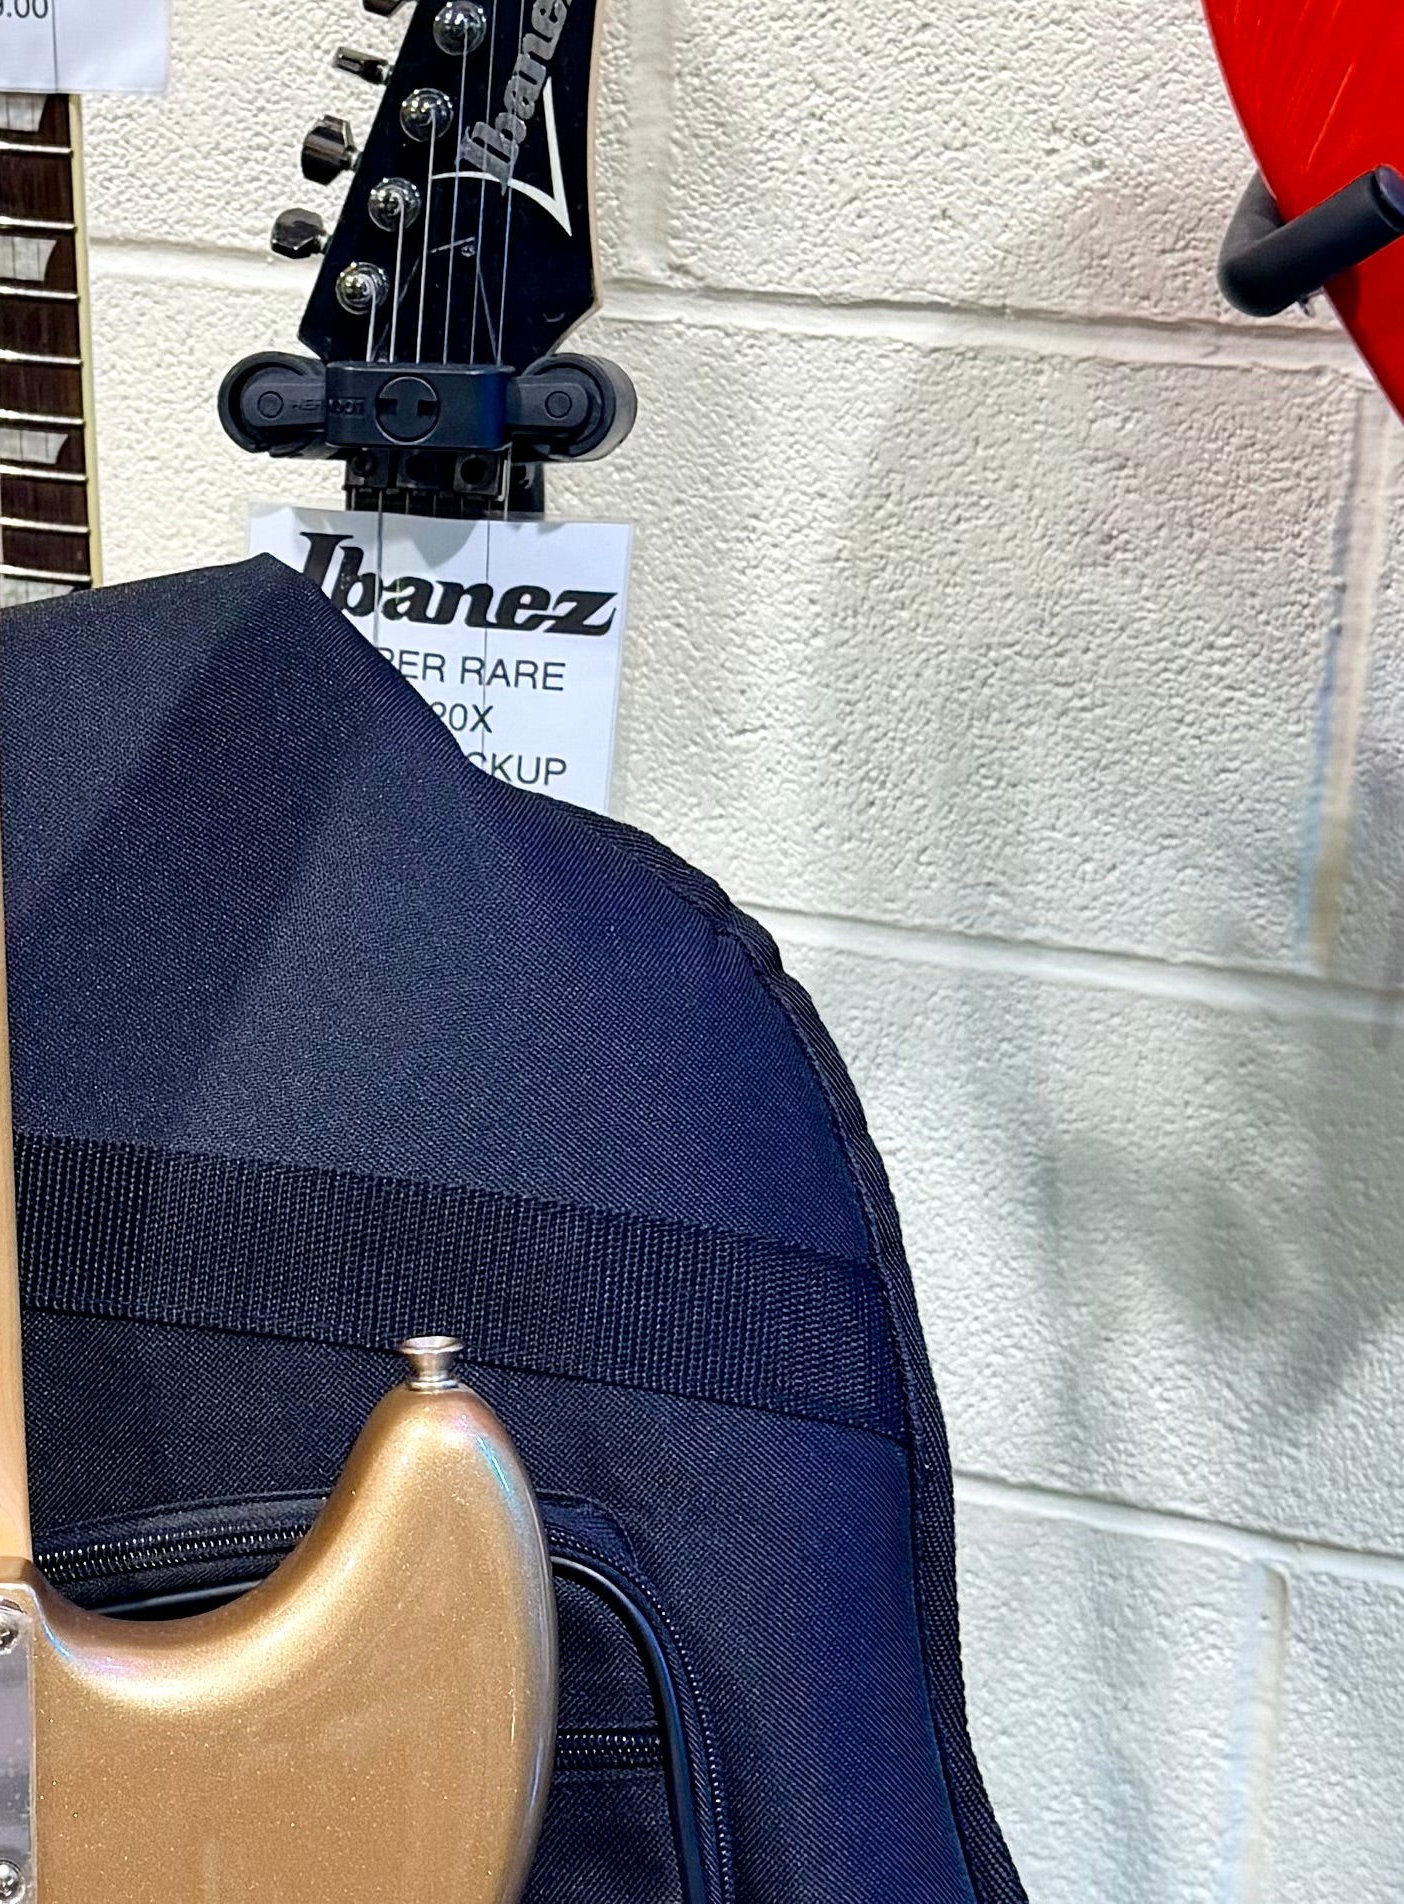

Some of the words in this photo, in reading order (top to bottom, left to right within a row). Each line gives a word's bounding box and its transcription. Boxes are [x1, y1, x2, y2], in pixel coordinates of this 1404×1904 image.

[300, 531, 618, 637] Ibanez
[460, 655, 567, 692] RARE
[468, 751, 568, 786] KUP
